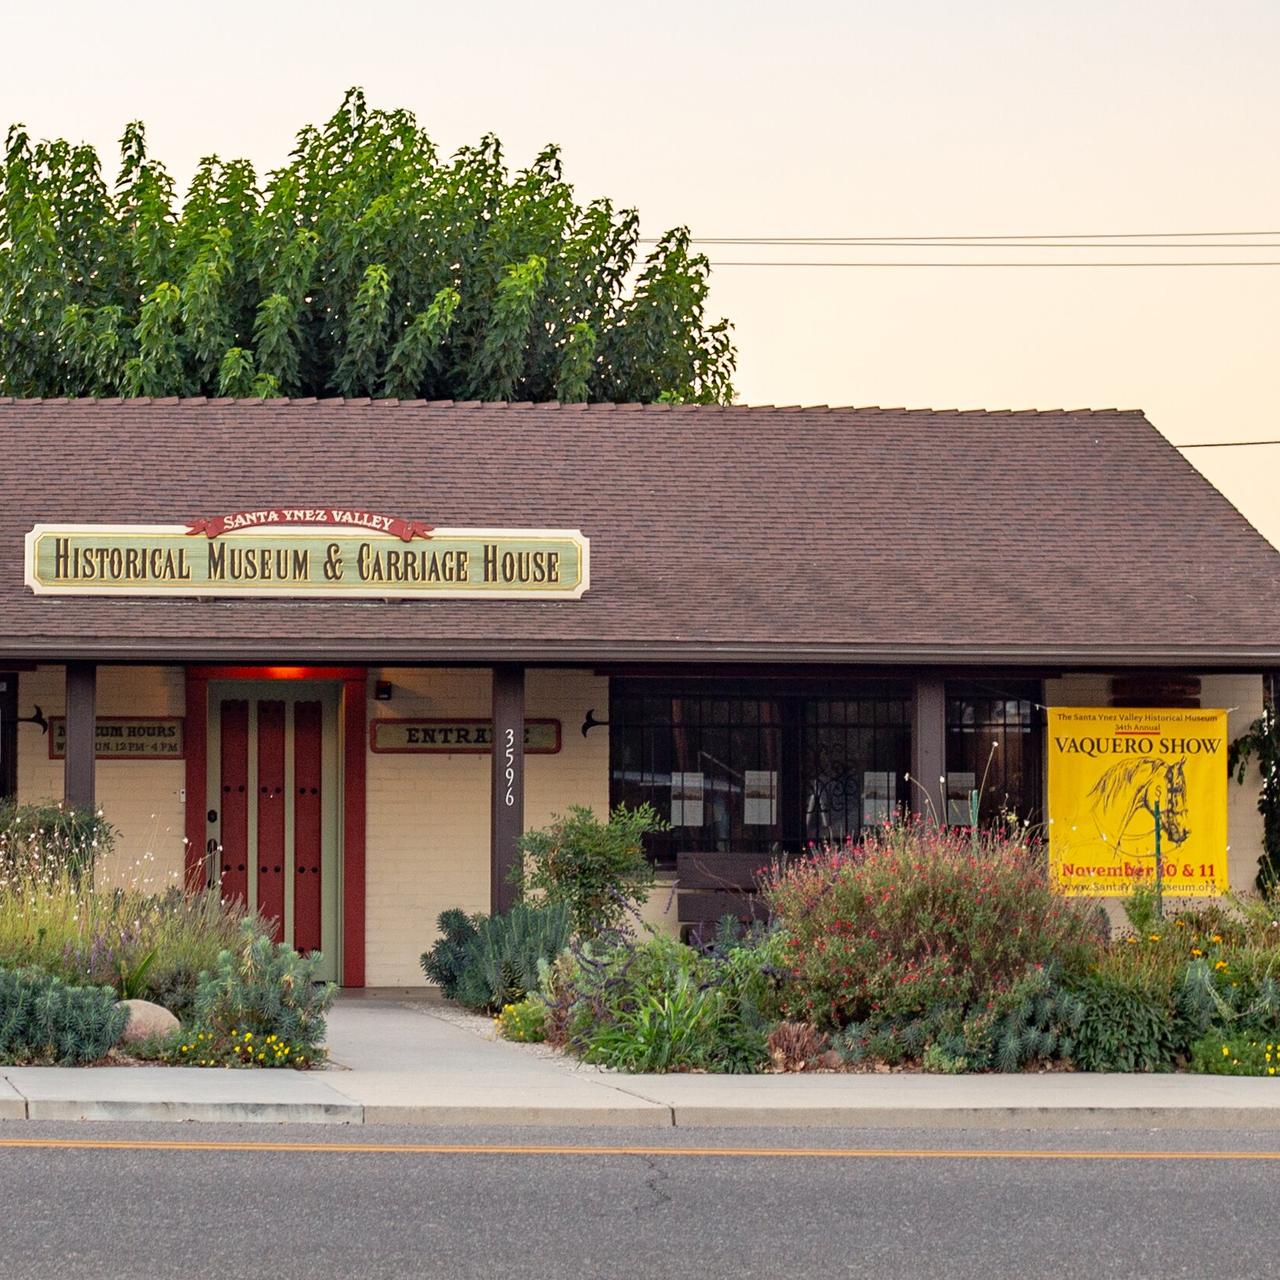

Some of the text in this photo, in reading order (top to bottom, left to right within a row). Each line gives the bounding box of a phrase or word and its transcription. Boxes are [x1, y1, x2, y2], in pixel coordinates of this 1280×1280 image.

[224, 509, 394, 531] SANTA YNEZ VALLEY
[55, 538, 560, 583] HISTORICAL MUSEUM & CARRIAGE HOUSE
[1058, 713, 1218, 723] The Santa Ynez Valley Historical Museum
[128, 726, 176, 737] HOURS
[1115, 723, 1160, 731] 34th Annual
[1055, 737, 1221, 757] VAQUERO SHOW
[504, 728, 515, 806] 3596
[1062, 862, 1153, 877] November
[1182, 864, 1194, 877] &
[1199, 864, 1215, 877] 11
